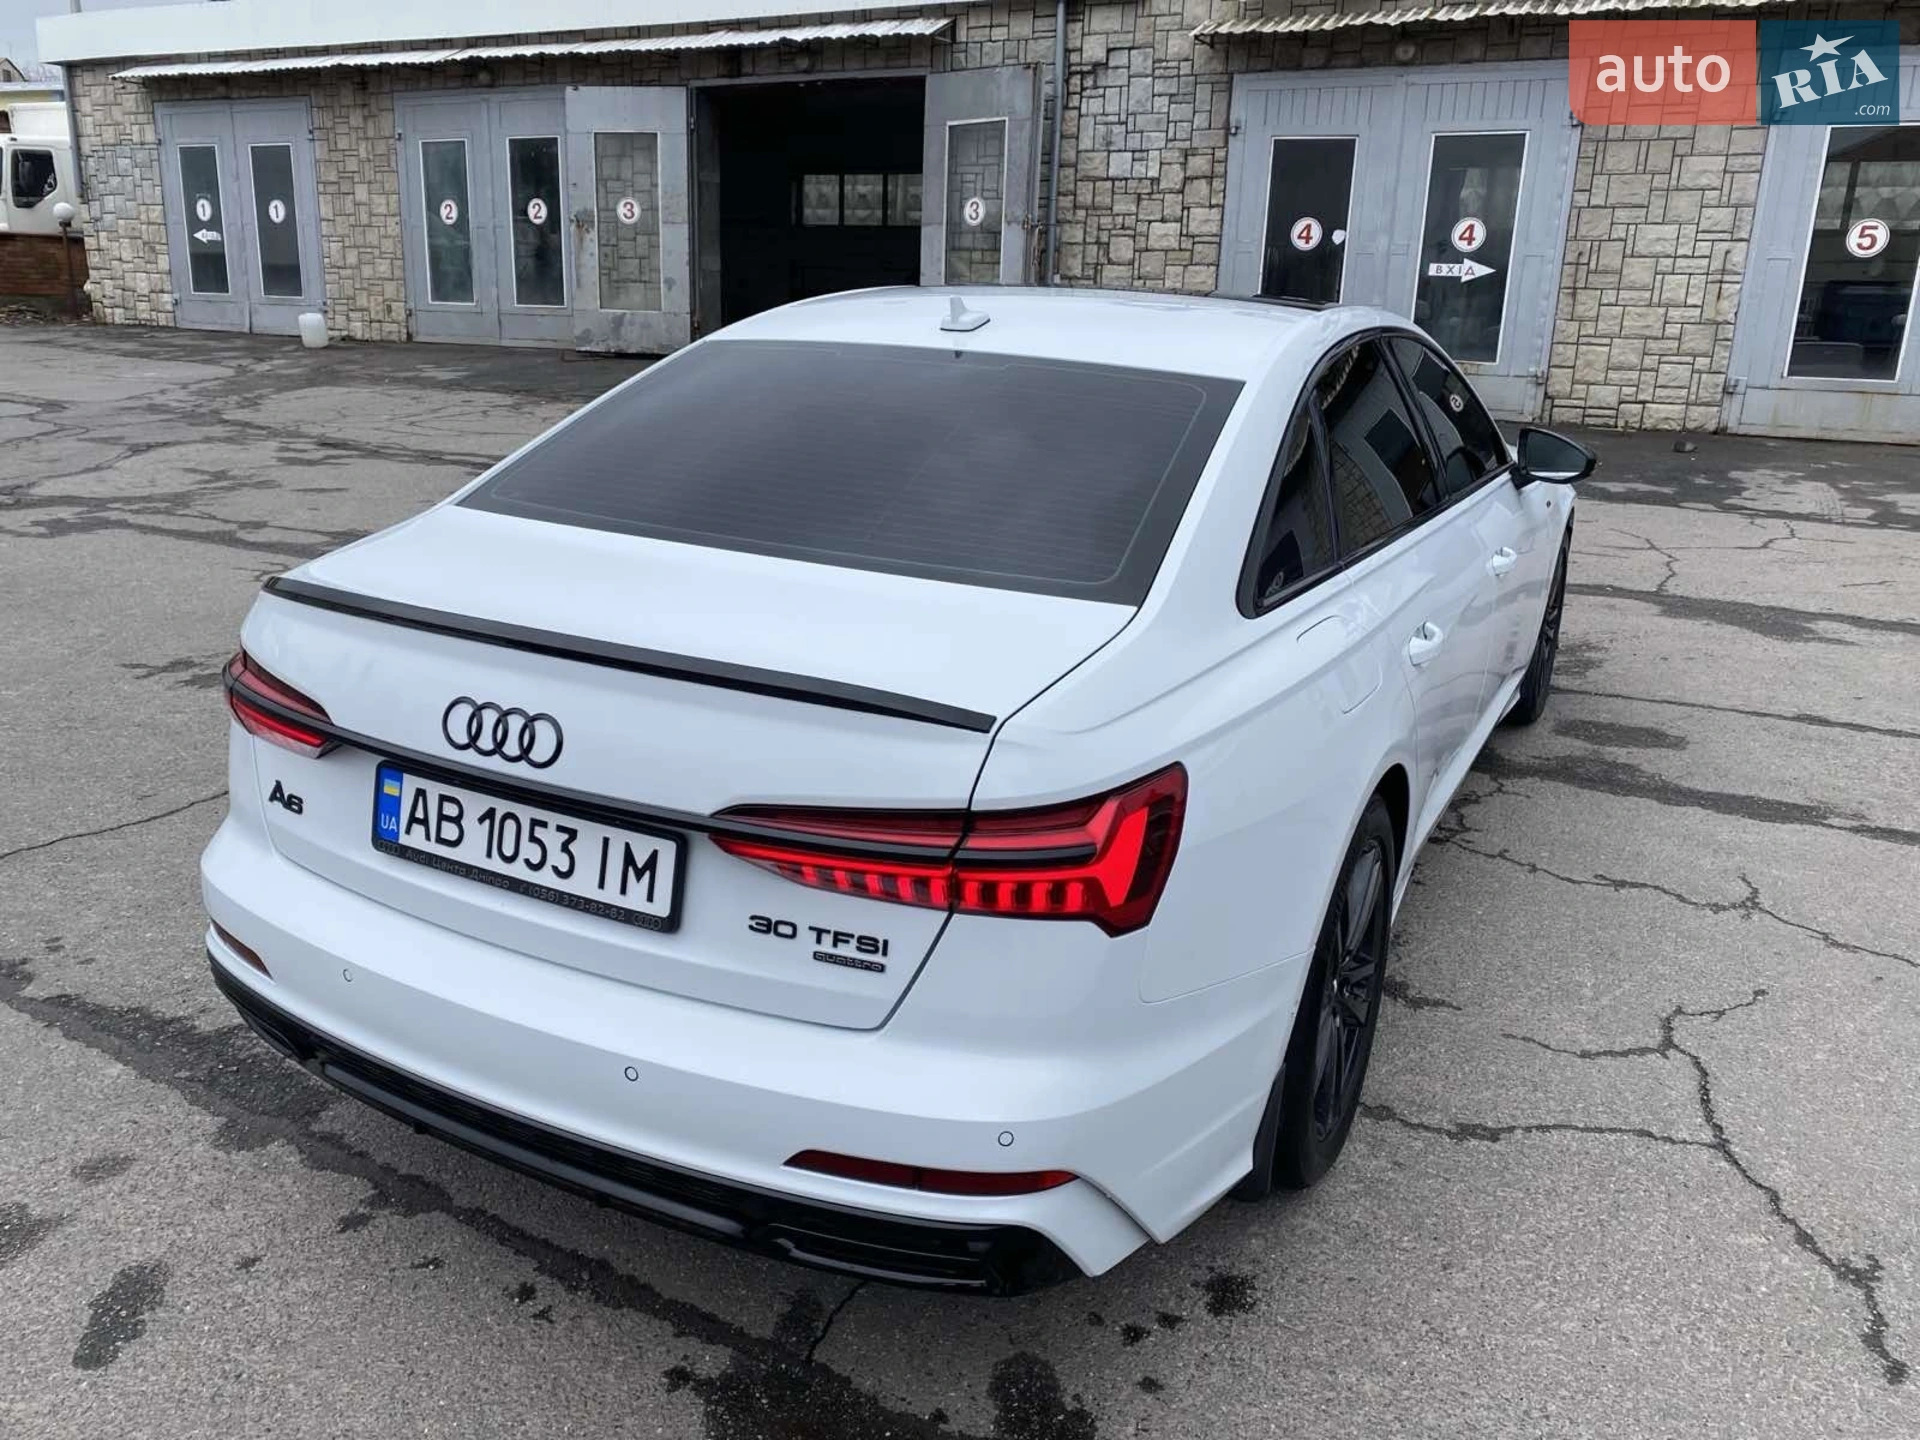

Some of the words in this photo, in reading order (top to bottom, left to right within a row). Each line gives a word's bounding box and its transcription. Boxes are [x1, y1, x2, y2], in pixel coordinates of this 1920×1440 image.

[444, 203, 453, 220] 2
[532, 202, 542, 220] 2
[623, 202, 635, 219] 3
[969, 201, 979, 221] 3
[1297, 223, 1313, 245] 4
[1458, 223, 1476, 246] 4
[1856, 225, 1879, 251] 5
[1436, 264, 1476, 276] ВХІД
[268, 779, 304, 815] A6
[380, 813, 398, 833] UA
[404, 786, 465, 848] AB
[477, 806, 578, 880] 1053
[597, 835, 660, 903] IM
[748, 914, 798, 940] 30
[808, 925, 889, 957] TFSI
[814, 951, 883, 972] quattro
